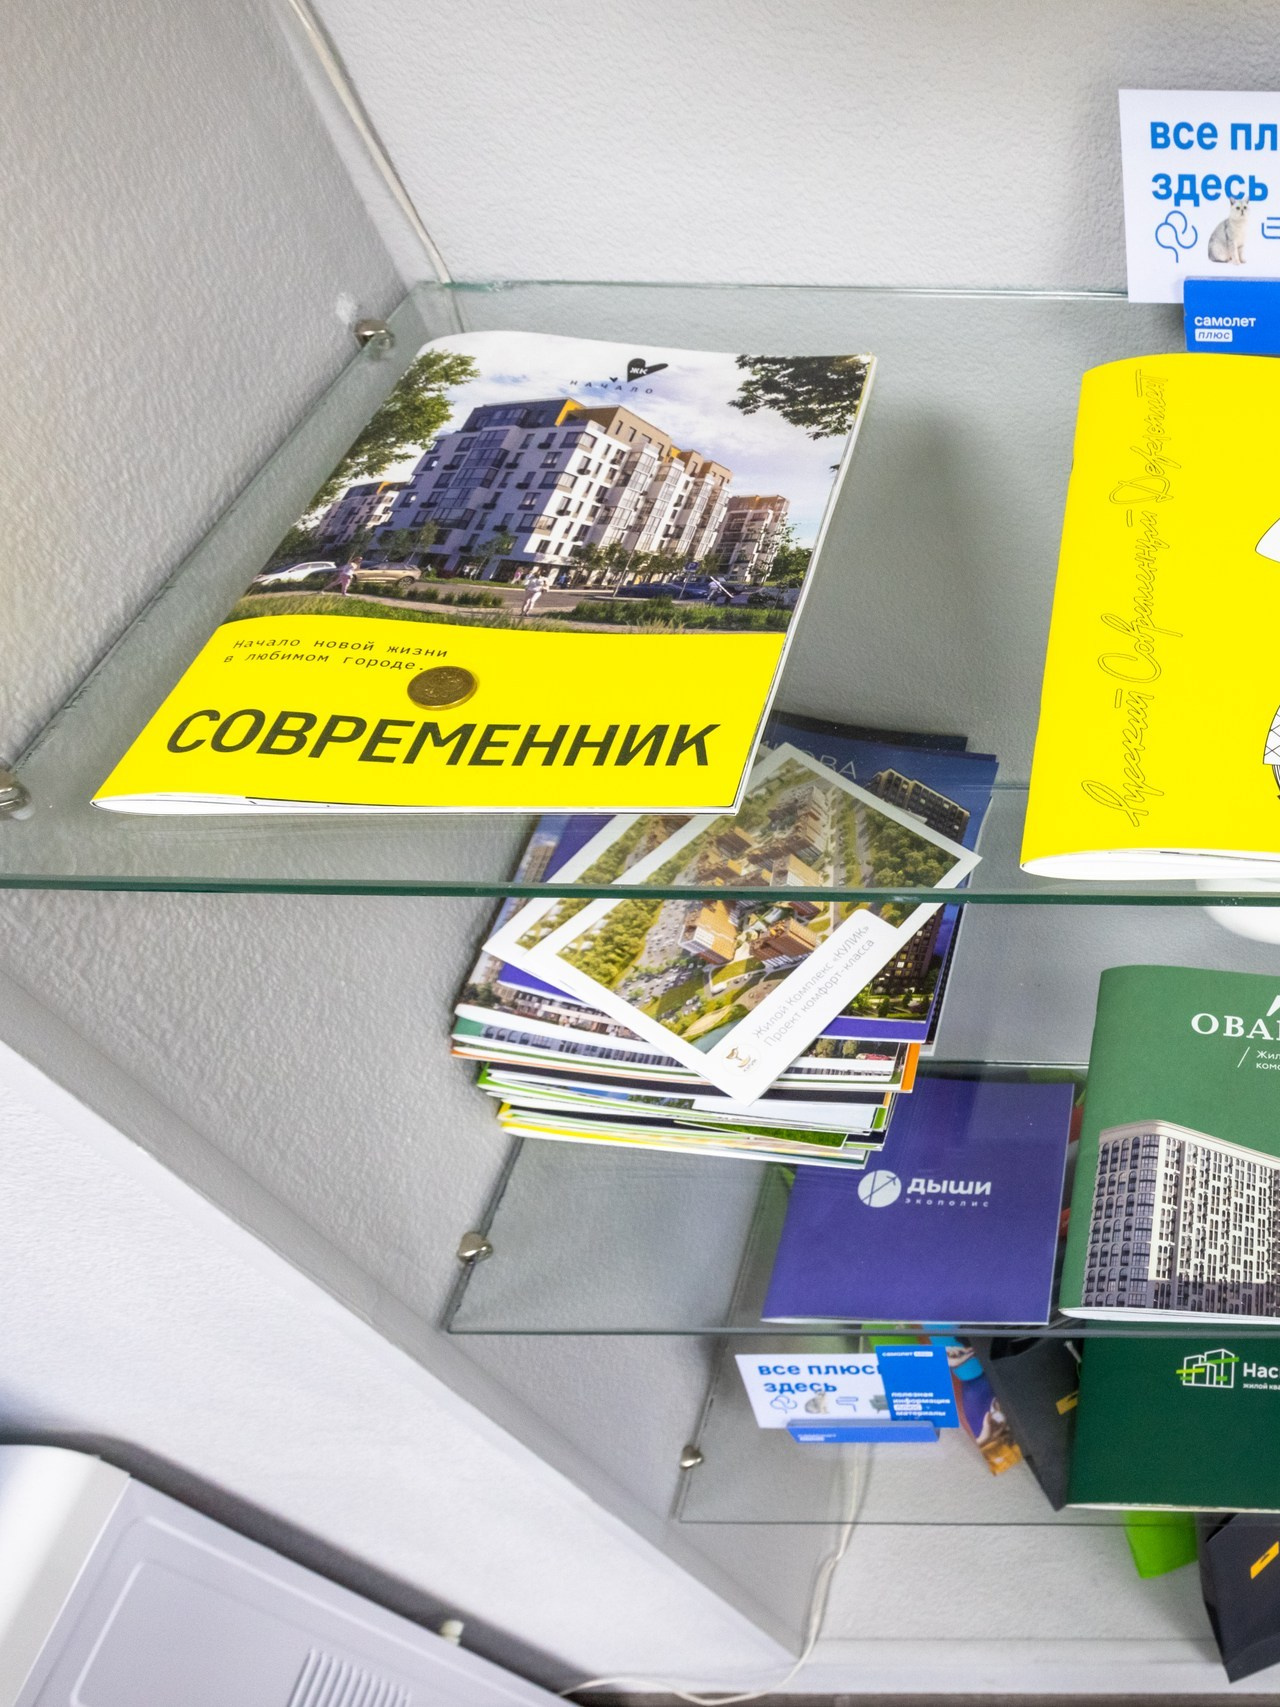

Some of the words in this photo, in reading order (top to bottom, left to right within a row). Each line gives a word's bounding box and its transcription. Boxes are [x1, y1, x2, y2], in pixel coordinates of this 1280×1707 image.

[1150, 122, 1218, 150] все
[1152, 173, 1269, 207] здесь
[1194, 316, 1256, 327] самолет
[570, 380, 653, 394] НАЧАЛО
[233, 639, 300, 649] Начало
[313, 640, 374, 652] новой
[387, 644, 448, 658] жизни
[224, 655, 234, 663] в
[245, 651, 329, 663] любимом
[343, 656, 424, 671] городе.
[166, 708, 721, 768] СОВРЕМЕННИК
[752, 1005, 788, 1039] Жилой
[787, 963, 834, 1006] Комплекс
[832, 926, 870, 962] «КУЛИК»
[764, 1015, 801, 1047] Проект
[802, 941, 875, 1013] комфорт-класса
[758, 1365, 800, 1375] все
[764, 1382, 838, 1394] здесь
